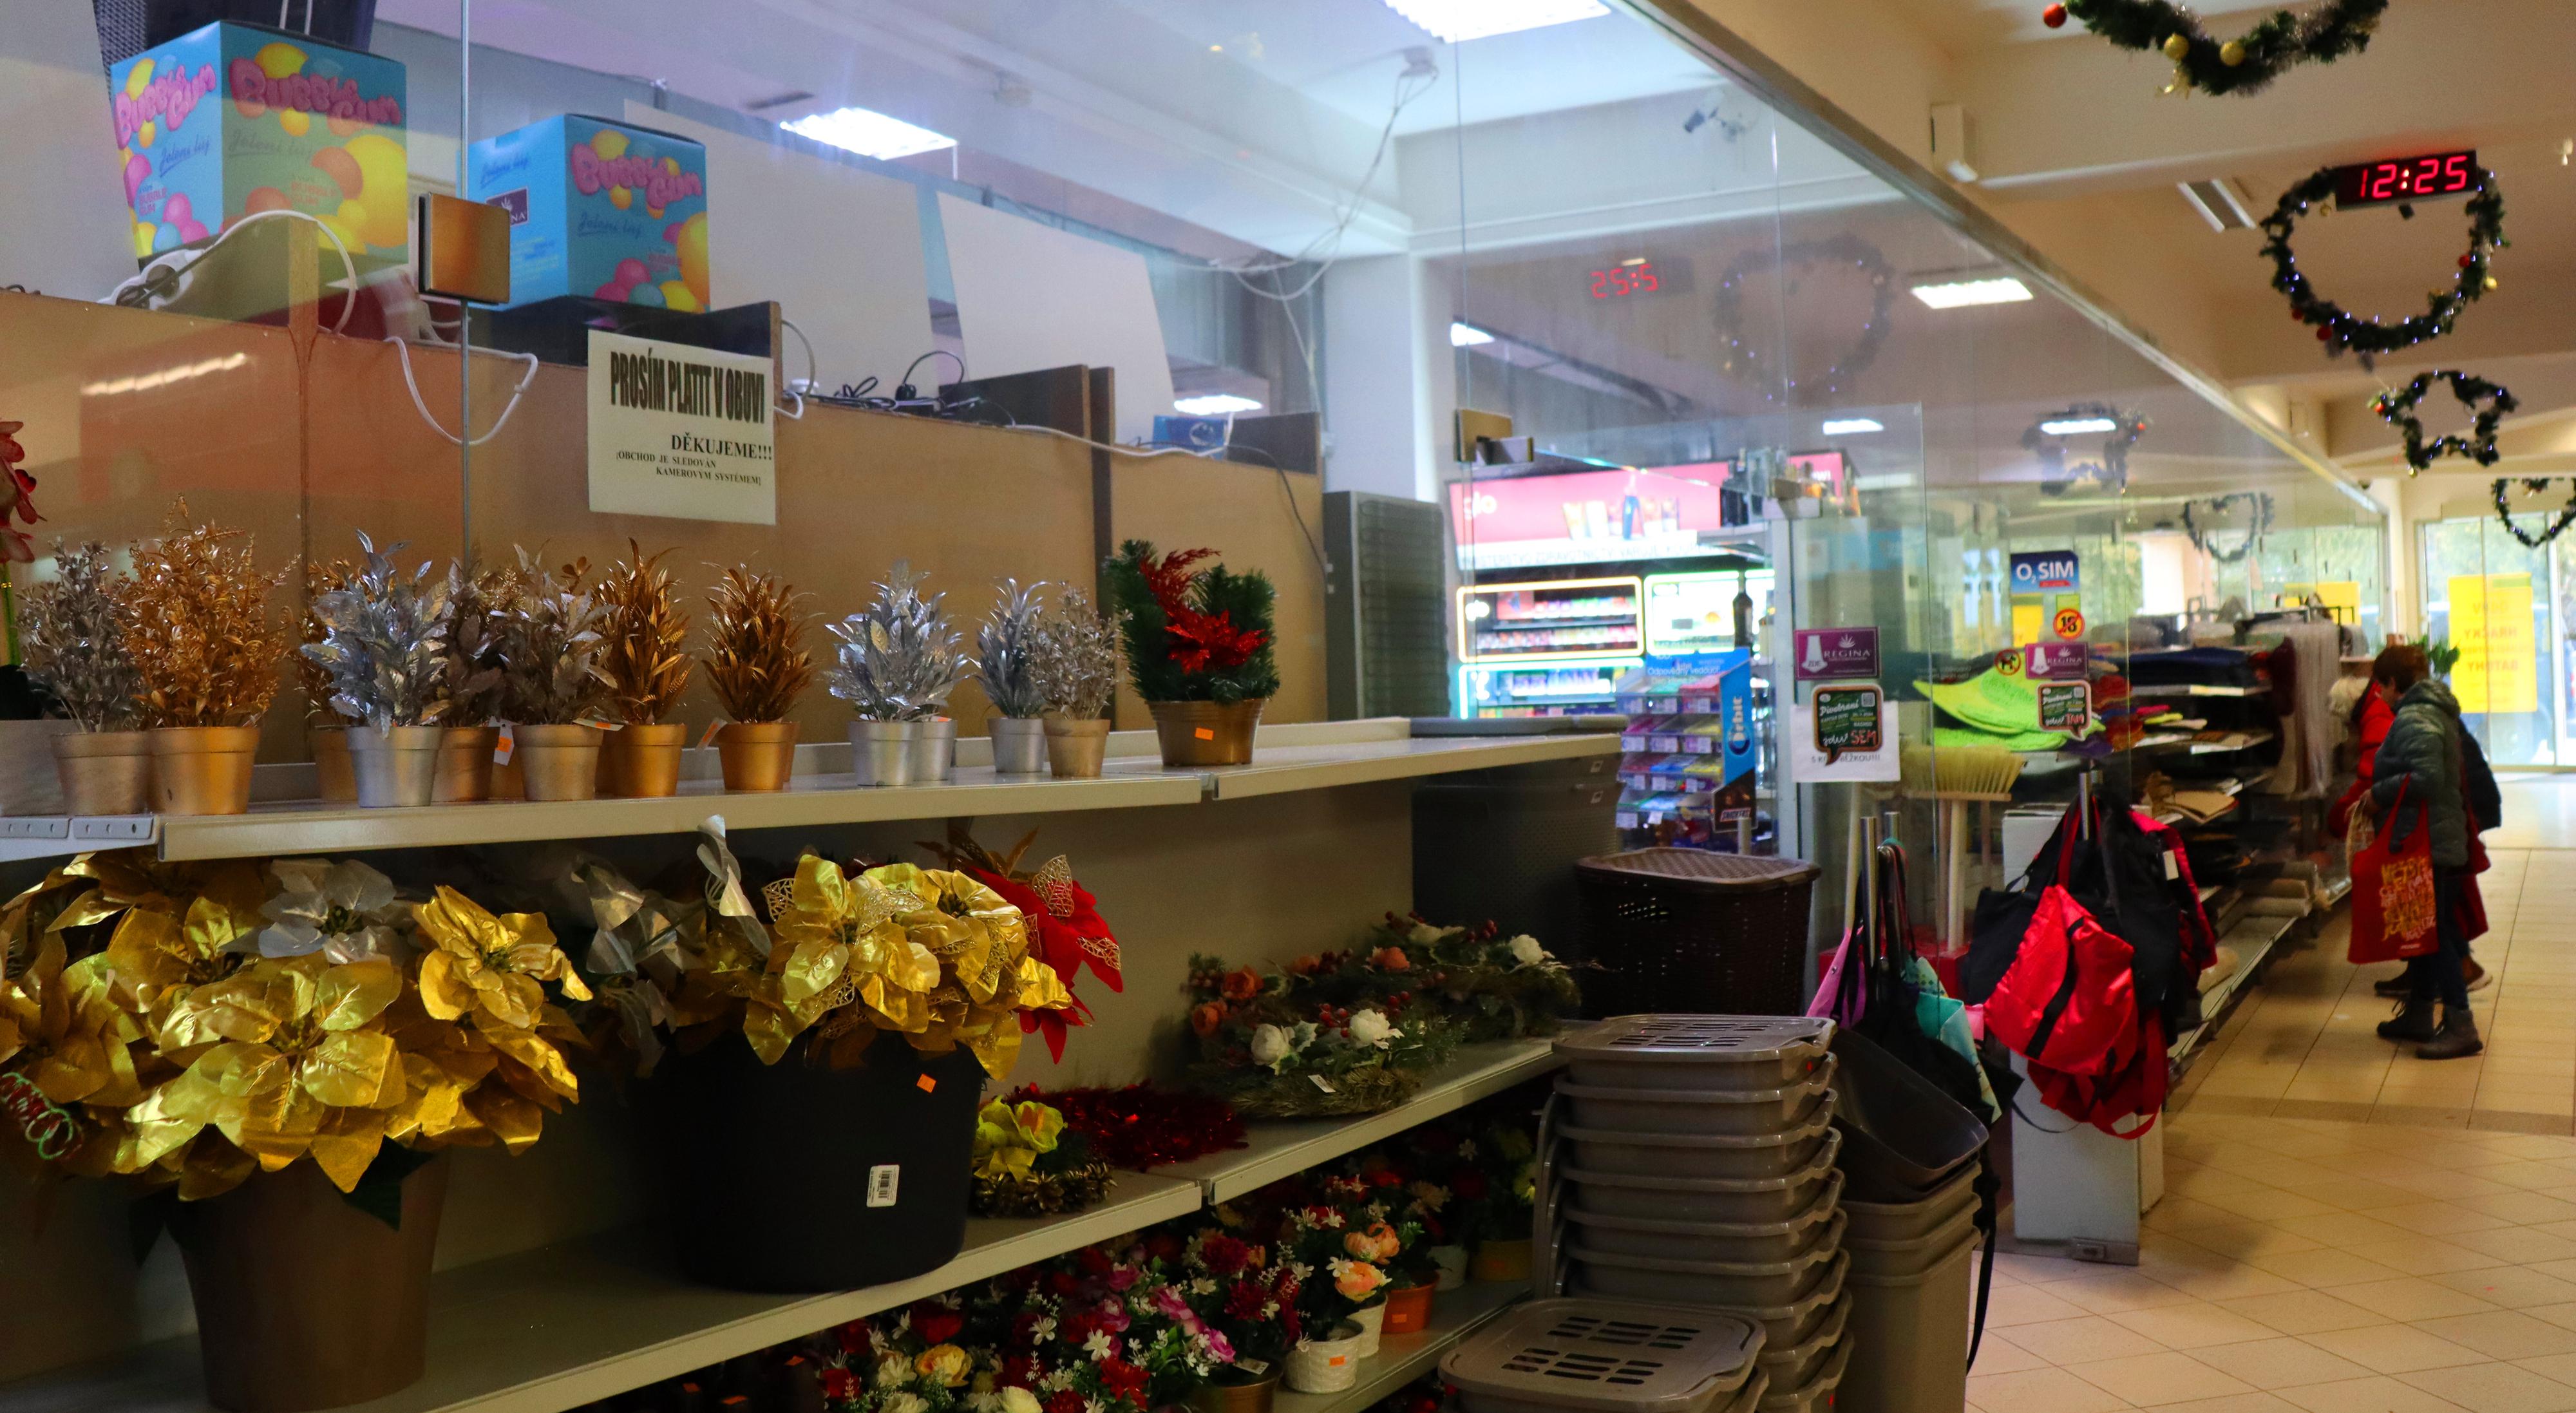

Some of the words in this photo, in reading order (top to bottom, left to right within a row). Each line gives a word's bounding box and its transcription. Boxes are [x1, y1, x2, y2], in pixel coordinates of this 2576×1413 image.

[2360, 155, 2468, 198] 12:25
[611, 346, 665, 412] PROSÍM
[668, 360, 712, 417] PLATIT
[714, 366, 724, 418] V
[726, 368, 765, 424] OBUVI
[671, 431, 772, 460] DĚKUJEME!!!
[659, 454, 670, 463] JE
[2038, 560, 2074, 580] SIM
[2061, 616, 2078, 632] 18
[1823, 649, 1871, 658] REGINA
[1851, 729, 1877, 745] SEM
